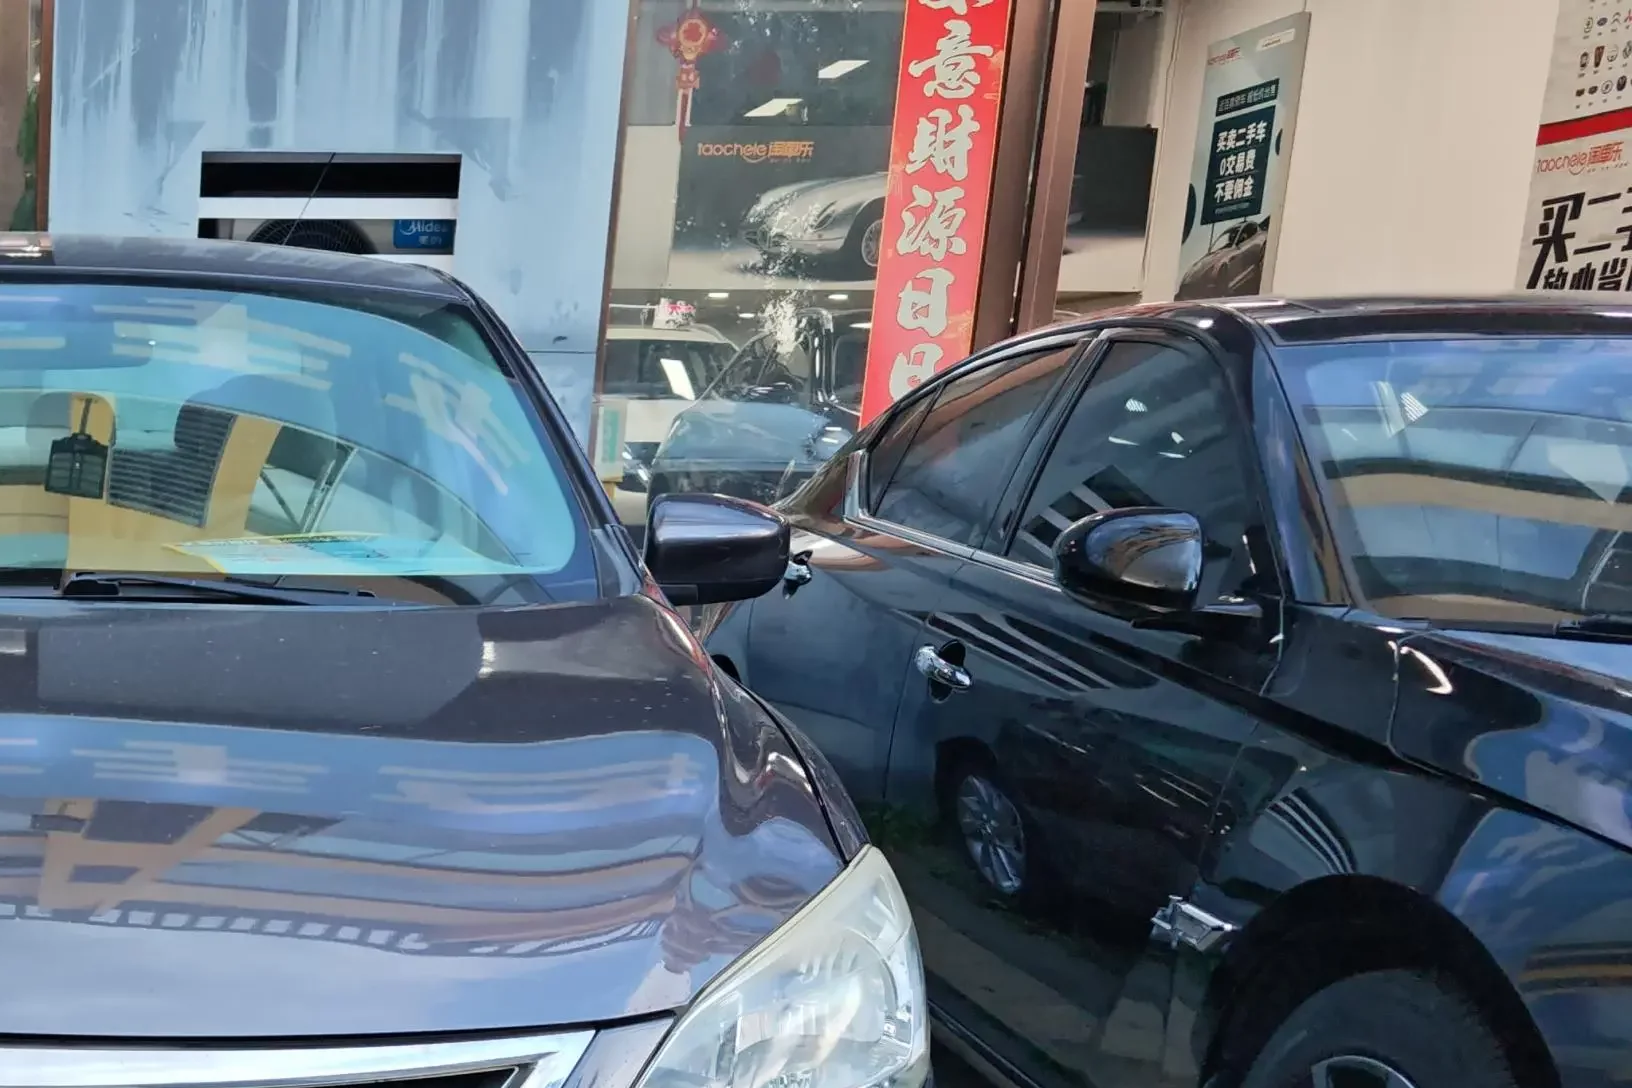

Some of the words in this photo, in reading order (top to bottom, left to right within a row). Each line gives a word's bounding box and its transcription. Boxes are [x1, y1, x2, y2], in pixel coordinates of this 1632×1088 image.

[1216, 121, 1267, 153] 买卖二手车
[889, 0, 995, 402] 意財源日日
[1214, 176, 1254, 203] 不要佣金
